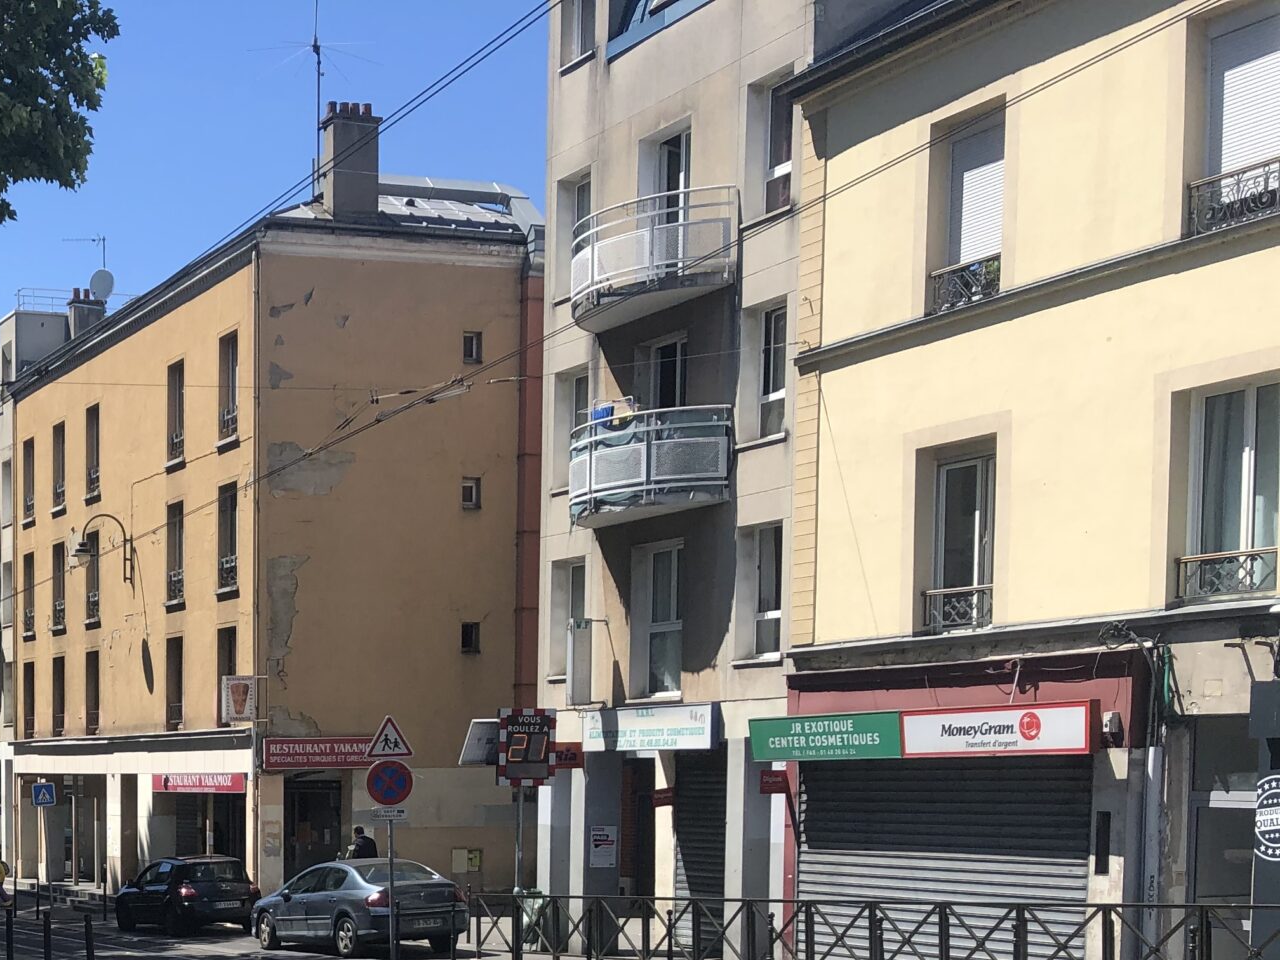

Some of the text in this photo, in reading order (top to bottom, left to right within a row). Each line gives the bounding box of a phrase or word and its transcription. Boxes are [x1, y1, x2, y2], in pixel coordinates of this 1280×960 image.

[518, 716, 541, 724] VOUS
[508, 725, 549, 733] ROULEZ A
[790, 719, 854, 734] JR EXOTIQUE
[940, 721, 1015, 739] MoneyGram
[769, 733, 880, 748] CENTER COSMETIQUES
[965, 739, 1018, 749] Transfert d'argent
[269, 743, 372, 754] RESTAURANT YAKAMO
[508, 734, 548, 761] 21
[269, 755, 308, 763] SPECIALITES
[161, 774, 232, 786] RSTAURANT YAKAMOZ
[1256, 808, 1280, 817] PRODU
